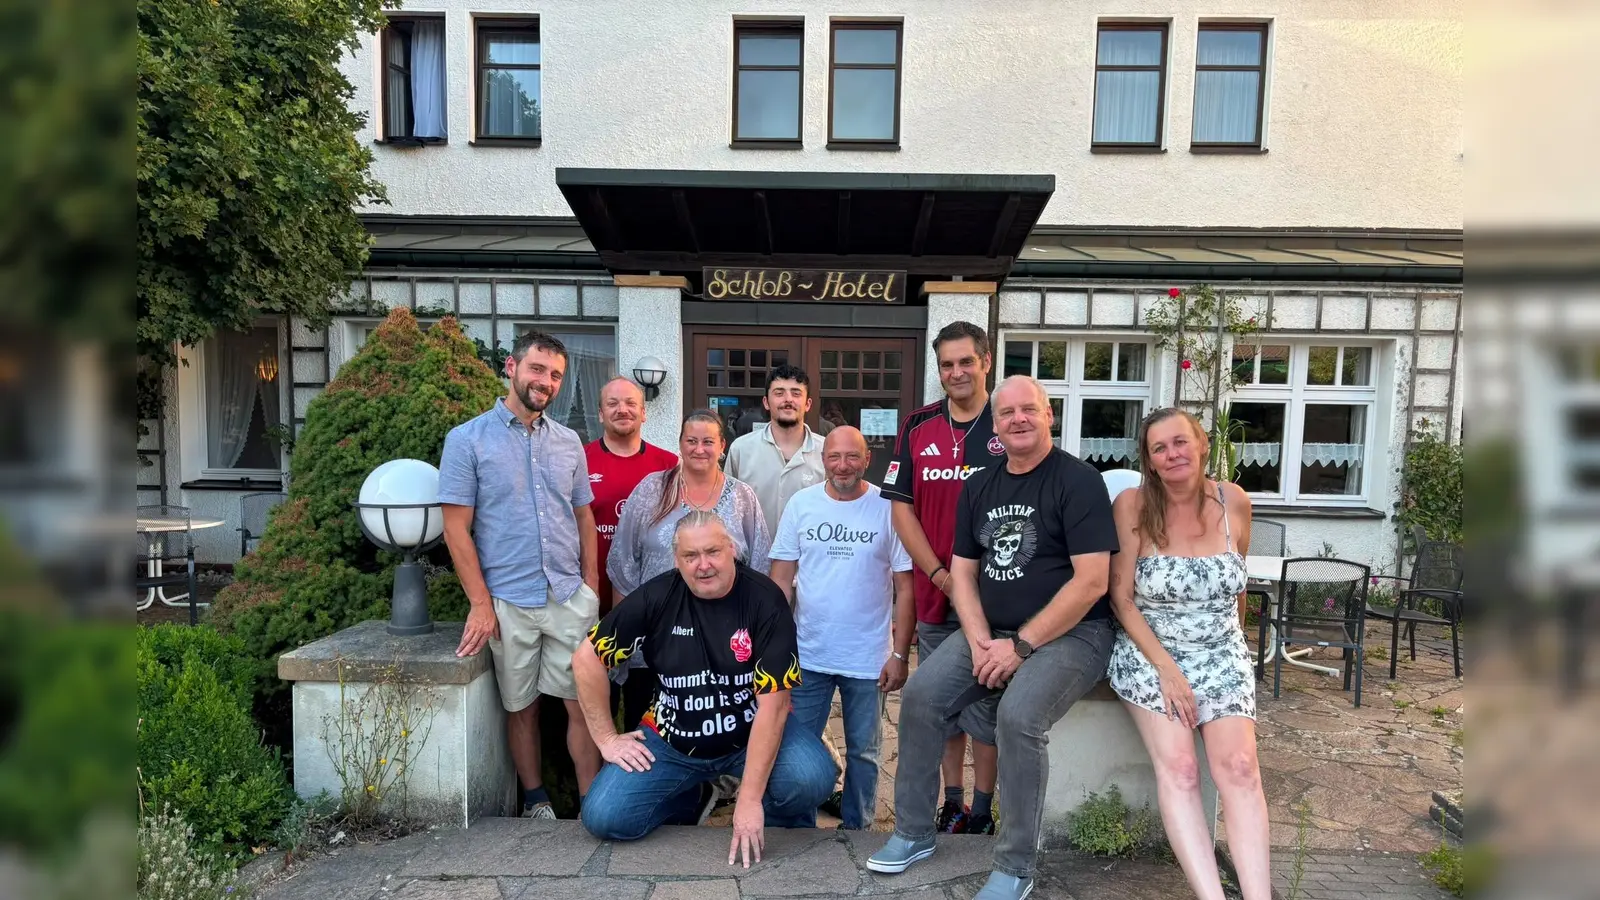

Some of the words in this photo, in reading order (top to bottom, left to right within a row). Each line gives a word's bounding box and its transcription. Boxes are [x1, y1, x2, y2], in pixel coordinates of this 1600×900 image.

[708, 269, 792, 299] Schloß
[812, 271, 897, 302] Hotel
[806, 521, 879, 544] s.Oliver
[984, 563, 1024, 581] POLICE
[671, 625, 694, 636] Albert
[684, 694, 714, 712] dou
